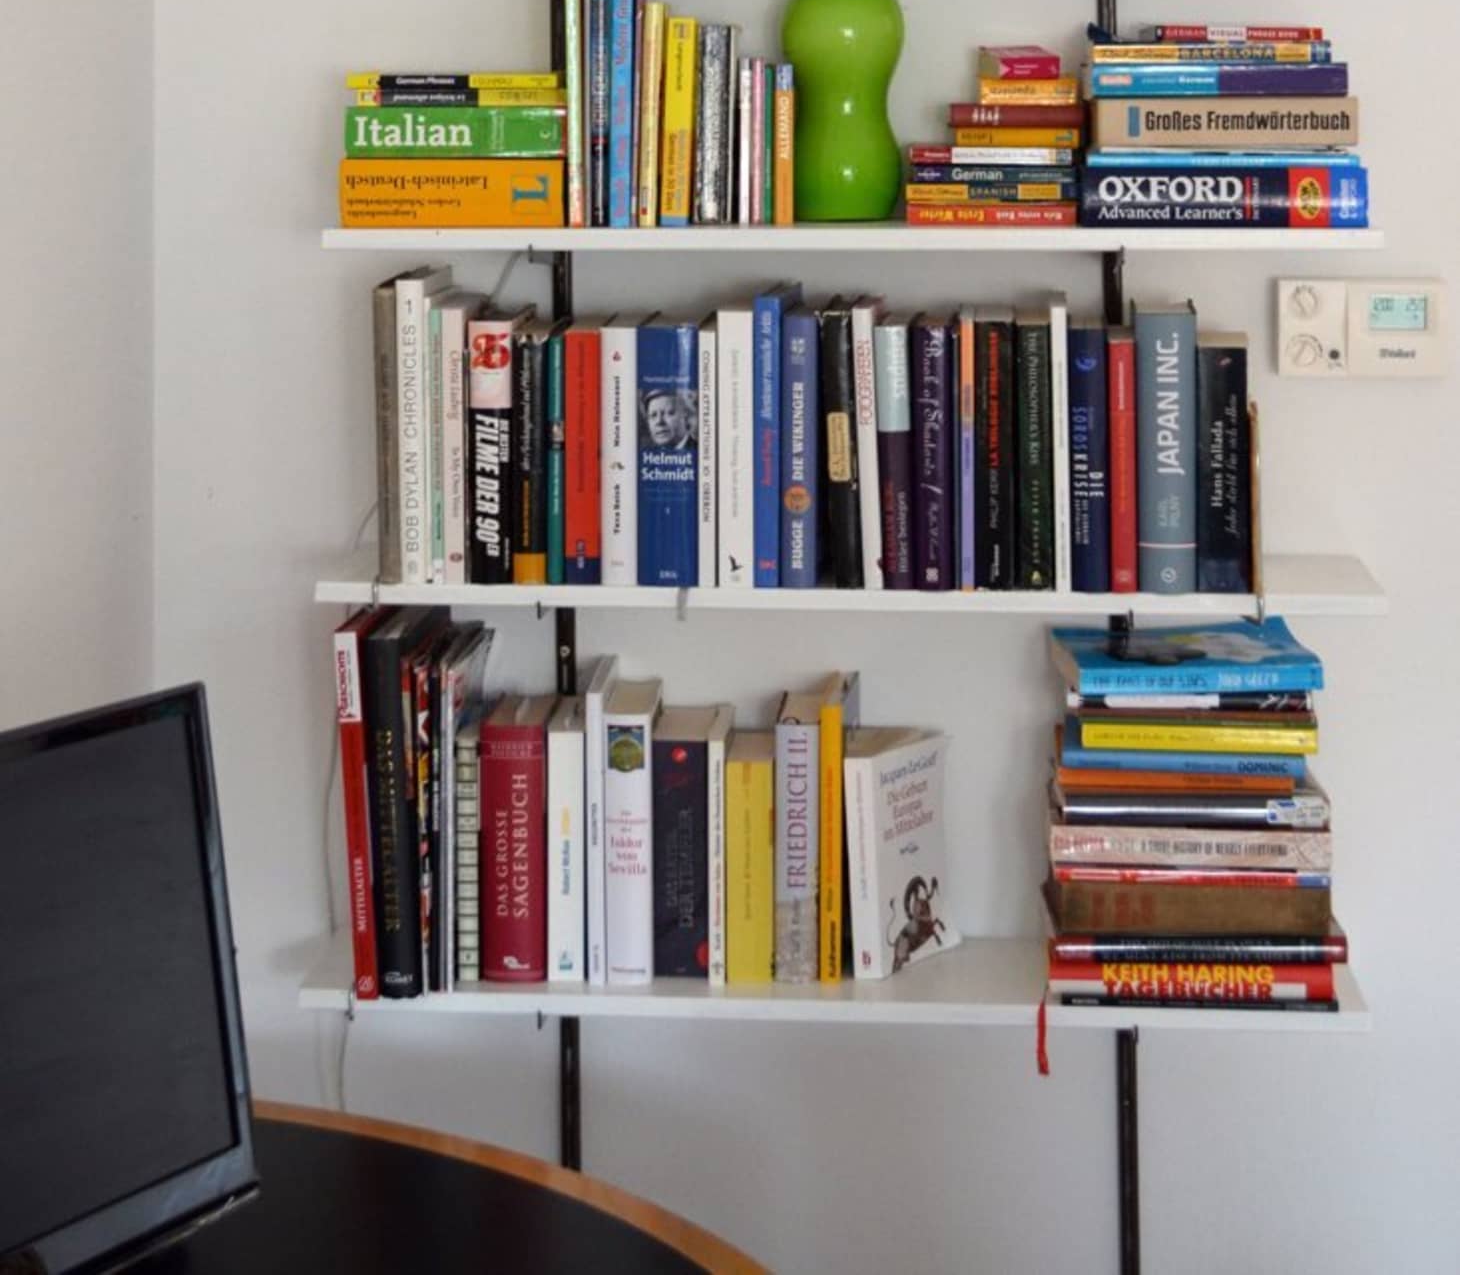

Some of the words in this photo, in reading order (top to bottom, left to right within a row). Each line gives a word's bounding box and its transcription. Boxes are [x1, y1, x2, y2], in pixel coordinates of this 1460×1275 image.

[355, 113, 473, 147] Italian
[778, 97, 791, 160] ALLEMAND
[1145, 111, 1201, 131] Großes
[1207, 111, 1349, 131] Fremdwörterbuch
[952, 168, 1003, 181] German
[1099, 176, 1244, 203] OXFORD
[1098, 205, 1171, 220] Advanced
[1174, 205, 1243, 220] Learner's
[1156, 332, 1180, 384] INC.
[402, 325, 418, 439] CHRONICLES
[792, 382, 804, 454] WIKINGER
[1156, 391, 1185, 475] JAPAN
[476, 415, 499, 474] FILME
[643, 452, 692, 465] Helmut
[1211, 421, 1223, 468] Fallada
[404, 452, 418, 510] DYLAN
[642, 467, 694, 481] Schmidt
[792, 457, 804, 481] DIE
[1073, 453, 1088, 497] KRISE
[1089, 472, 1104, 497] DIE
[476, 476, 499, 515] DER
[1211, 474, 1223, 507] Hans
[405, 516, 418, 553] BOB
[377, 730, 394, 771] DAS
[788, 732, 808, 756] II.
[496, 810, 508, 877] GROSSE
[787, 760, 808, 888] FRIEDRICH
[512, 775, 528, 917] SAGENBUCH
[353, 858, 367, 932] MITTELALTER
[496, 884, 508, 916] DAS
[1102, 963, 1169, 982] KEITH
[1176, 964, 1276, 984] HARING
